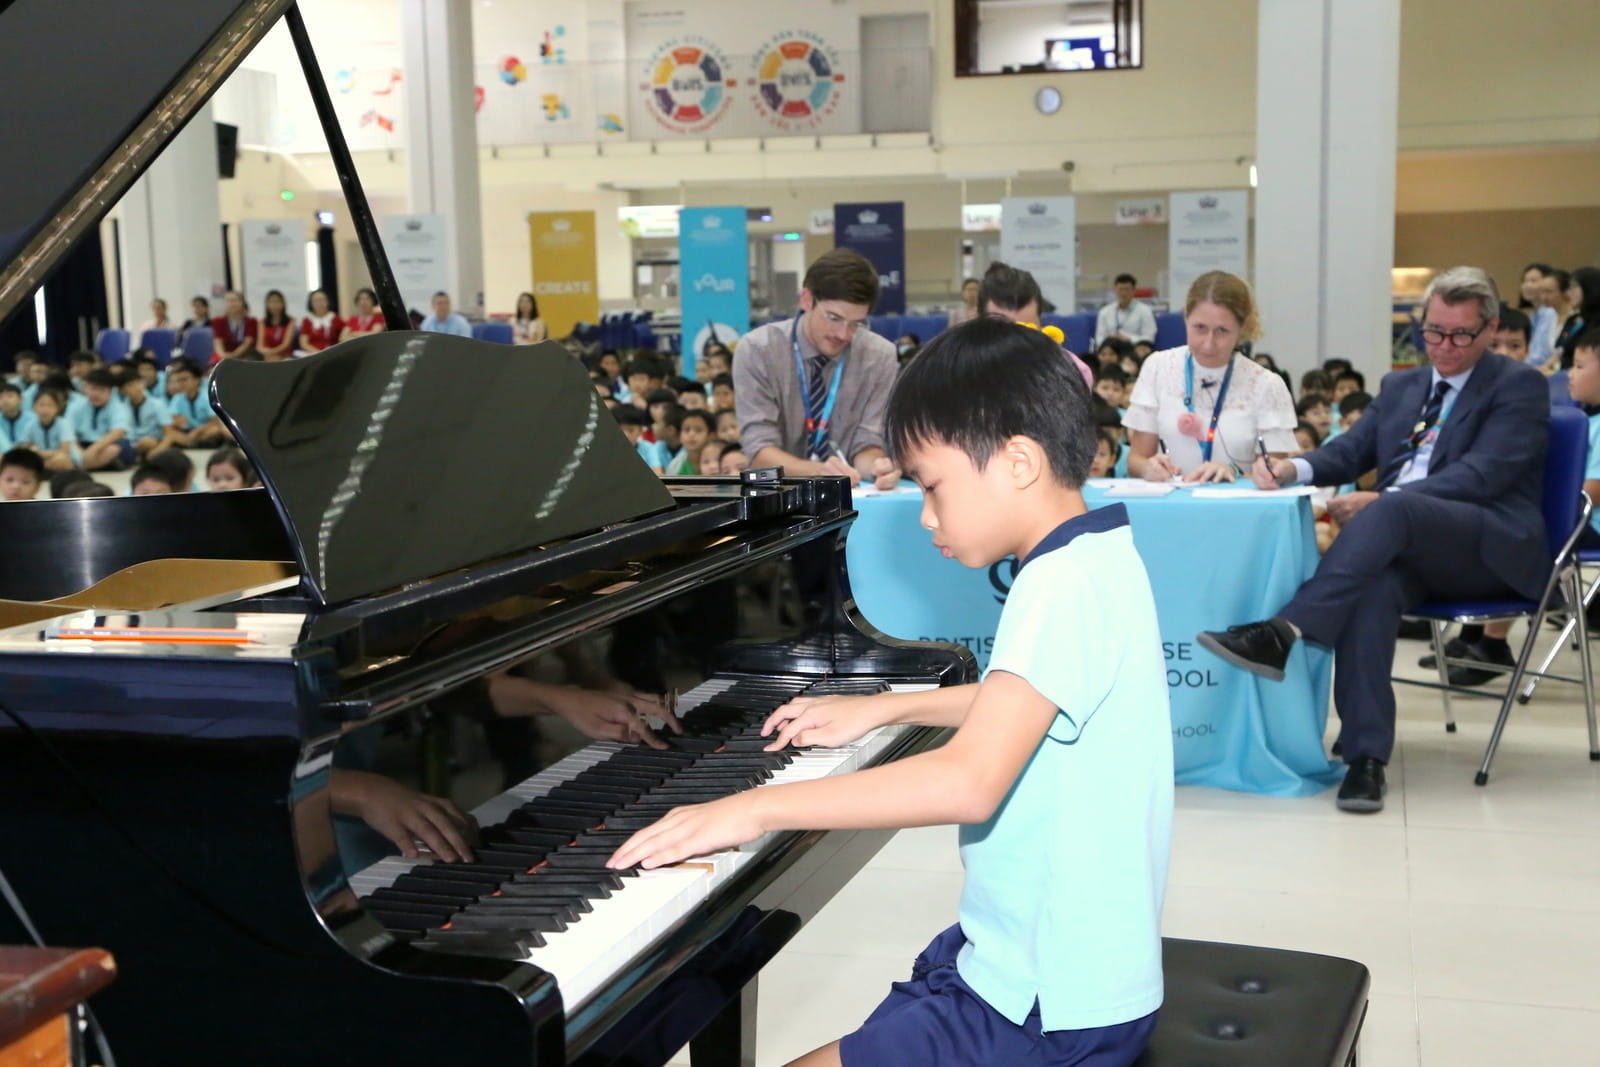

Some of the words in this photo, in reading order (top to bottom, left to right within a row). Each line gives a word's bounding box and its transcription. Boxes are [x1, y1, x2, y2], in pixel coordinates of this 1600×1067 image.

[1119, 206, 1149, 218] Line
[813, 215, 834, 228] Lin
[693, 273, 736, 293] YOUR
[879, 270, 900, 287] RE
[535, 281, 592, 296] CREATE
[1162, 642, 1192, 661] SE
[1167, 668, 1219, 688] OOL
[1173, 722, 1216, 738] HOOL
